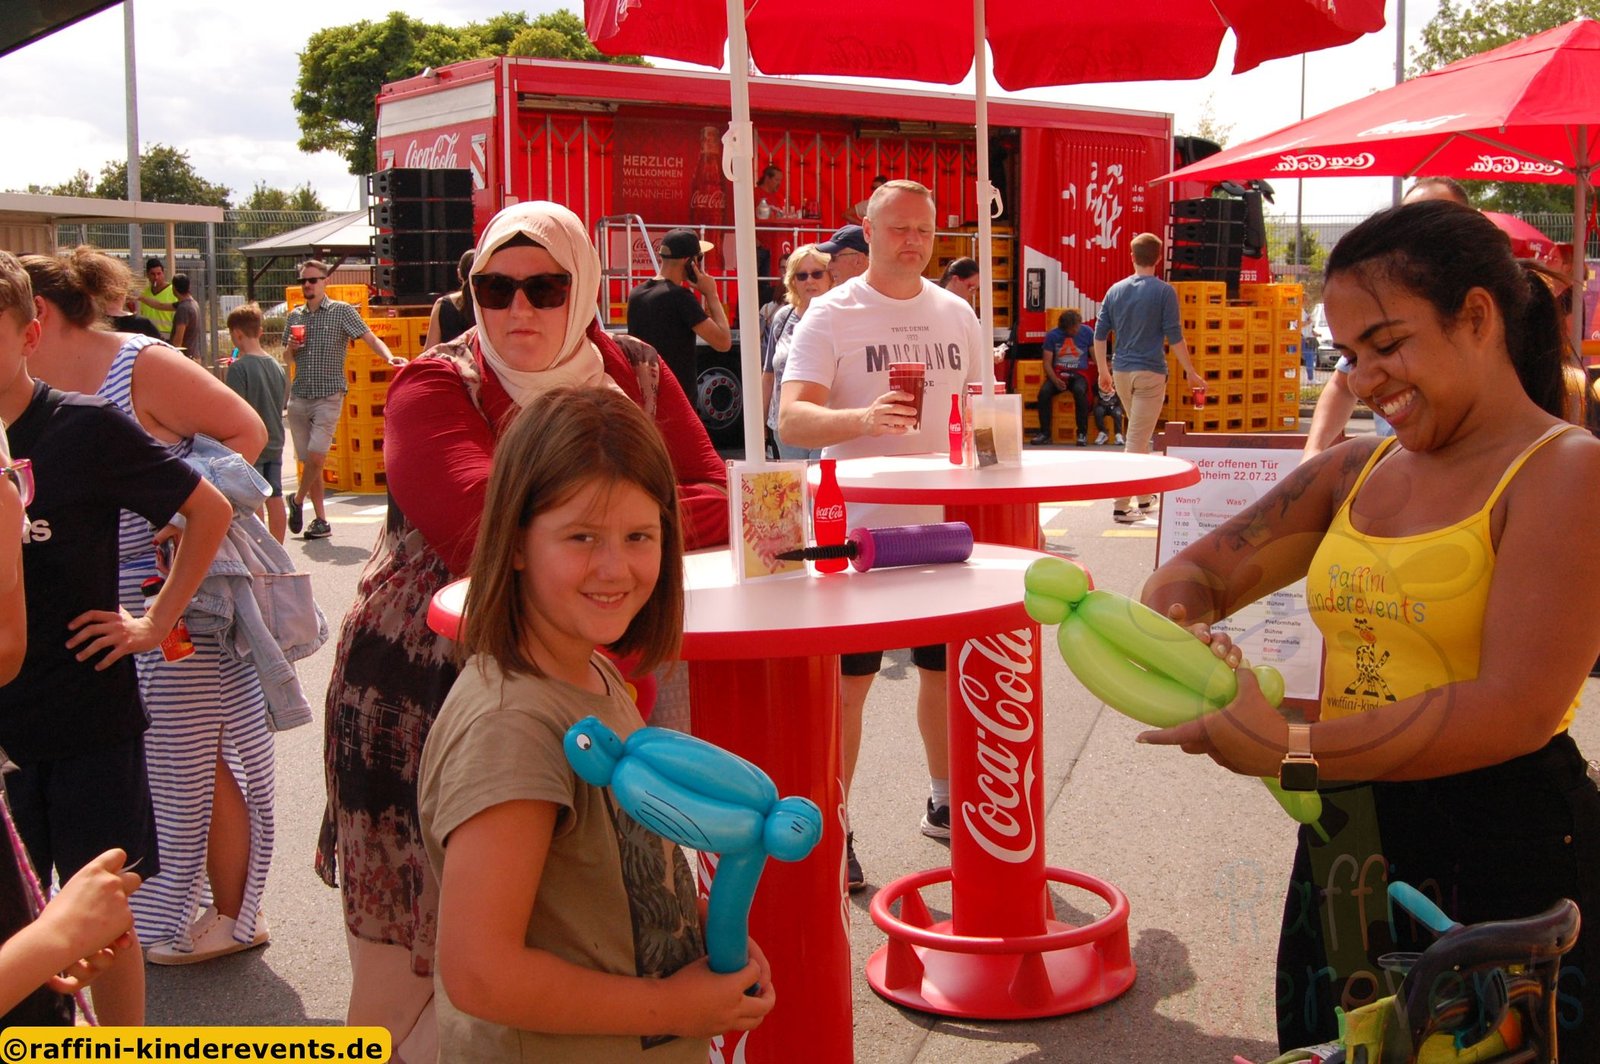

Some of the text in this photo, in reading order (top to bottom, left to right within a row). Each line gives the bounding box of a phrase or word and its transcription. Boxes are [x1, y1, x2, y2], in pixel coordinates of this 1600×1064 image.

[623, 155, 684, 168] HERZLICH
[622, 167, 683, 178] WILLKOMMEN
[638, 179, 683, 188] STANDORT
[622, 188, 683, 199] MANNHEIM
[865, 343, 961, 373] MUSTANG
[1198, 459, 1214, 468] der
[1217, 459, 1257, 469] offenen
[1260, 460, 1279, 469] Tür
[1199, 471, 1277, 481] nheim 22.07.23
[1328, 564, 1387, 593] Raffini
[1310, 587, 1427, 624] inderevents
[958, 627, 1037, 863] Coca-Cola
